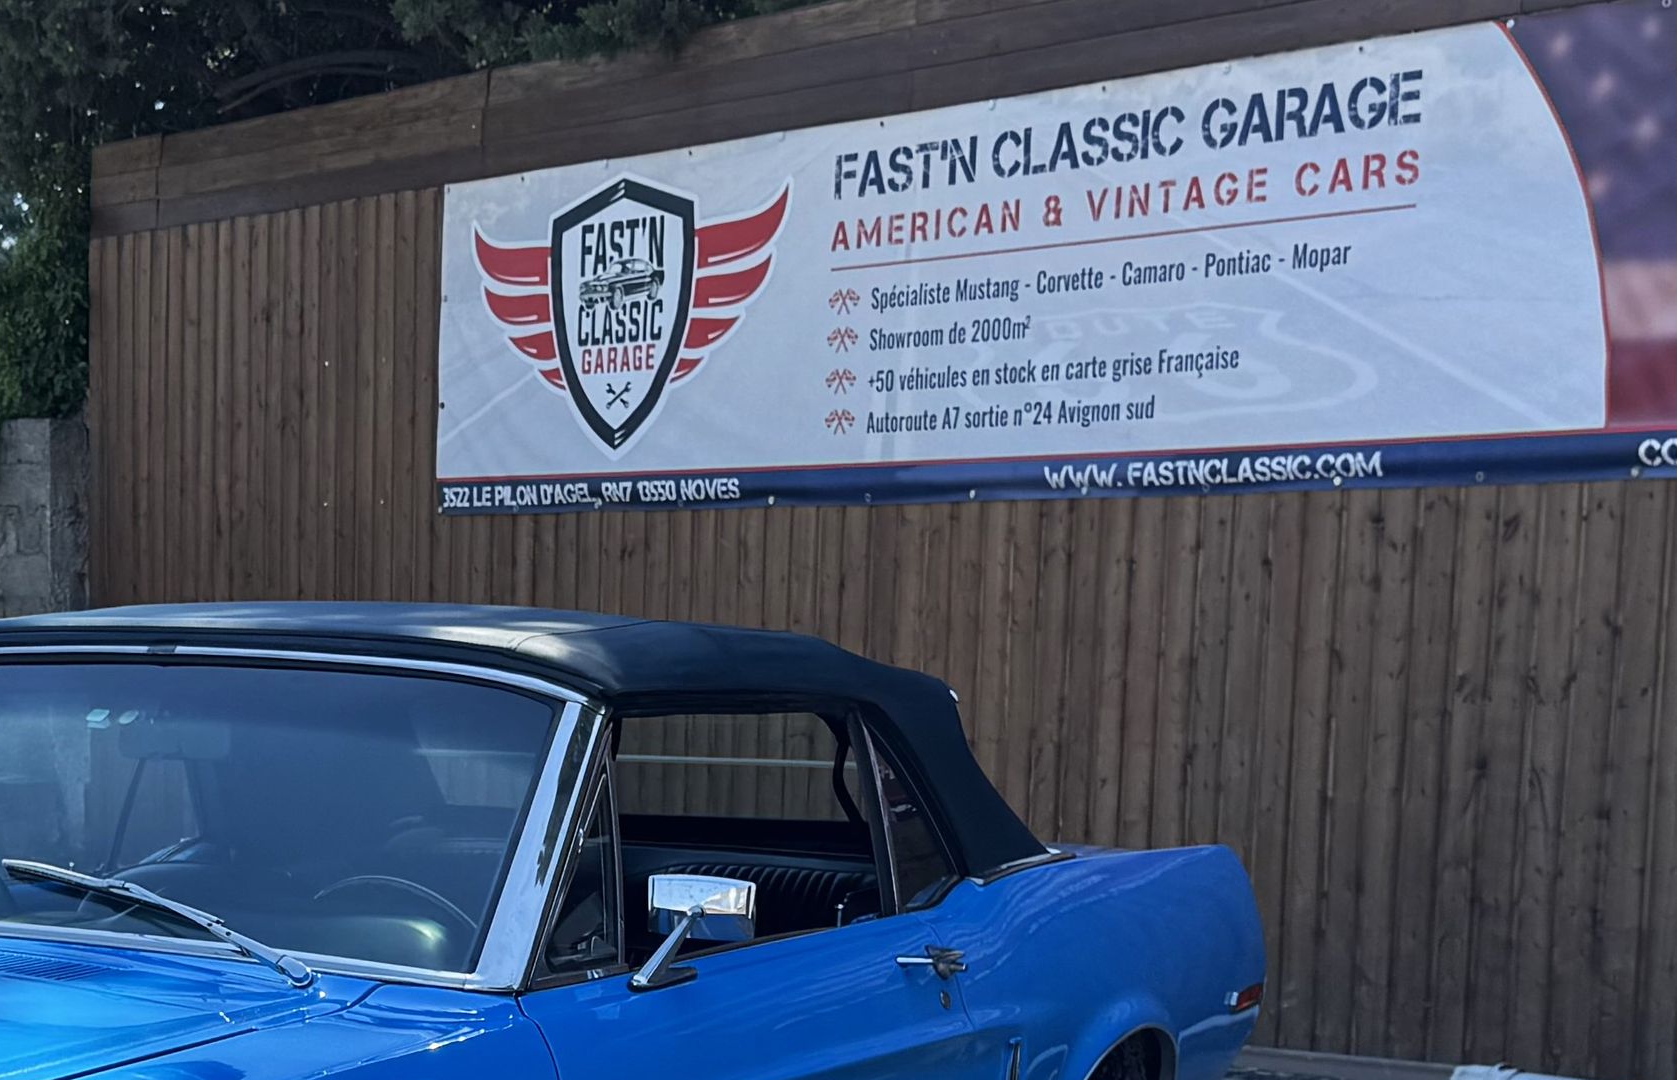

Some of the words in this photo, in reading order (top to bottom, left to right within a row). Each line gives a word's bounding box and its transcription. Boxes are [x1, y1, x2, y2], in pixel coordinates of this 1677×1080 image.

[834, 135, 978, 200] FAST'N
[992, 105, 1185, 179] CLASSIC
[1201, 69, 1423, 149] GARAGE
[830, 199, 1021, 252] AMERICAN
[1043, 195, 1063, 228] &
[1087, 167, 1269, 222] VINTAGE
[1294, 149, 1421, 197] CARS
[580, 215, 665, 278] FAST'N
[871, 283, 950, 313] Spécialiste
[955, 278, 1020, 302] Mustang
[1037, 267, 1104, 294] Corvette
[1122, 261, 1185, 286] Camaro
[1204, 249, 1272, 279] Pontiac
[1292, 243, 1352, 272] Mopar
[577, 299, 663, 347] CLASSIC
[869, 327, 943, 351] Showroom
[948, 321, 966, 345] de
[971, 315, 1031, 343] 2000m²
[581, 343, 656, 375] GARAGE
[868, 369, 894, 393] +50
[899, 365, 967, 391] véhicules
[972, 368, 990, 386] en
[995, 359, 1036, 385] stock
[1041, 363, 1060, 382] en
[1065, 356, 1107, 381] carte
[1112, 352, 1152, 383] grise
[1158, 345, 1239, 379] Française
[867, 409, 937, 434] Autoroute
[942, 406, 960, 431] A7
[964, 404, 1009, 429] sortie
[1057, 400, 1120, 428] Avignon
[1126, 394, 1156, 420] sud
[443, 487, 470, 508] 3522
[473, 487, 491, 506] LE
[494, 484, 538, 506] PILON
[601, 481, 632, 502] RN7
[637, 480, 676, 502] 13550
[679, 477, 741, 501] NOVES
